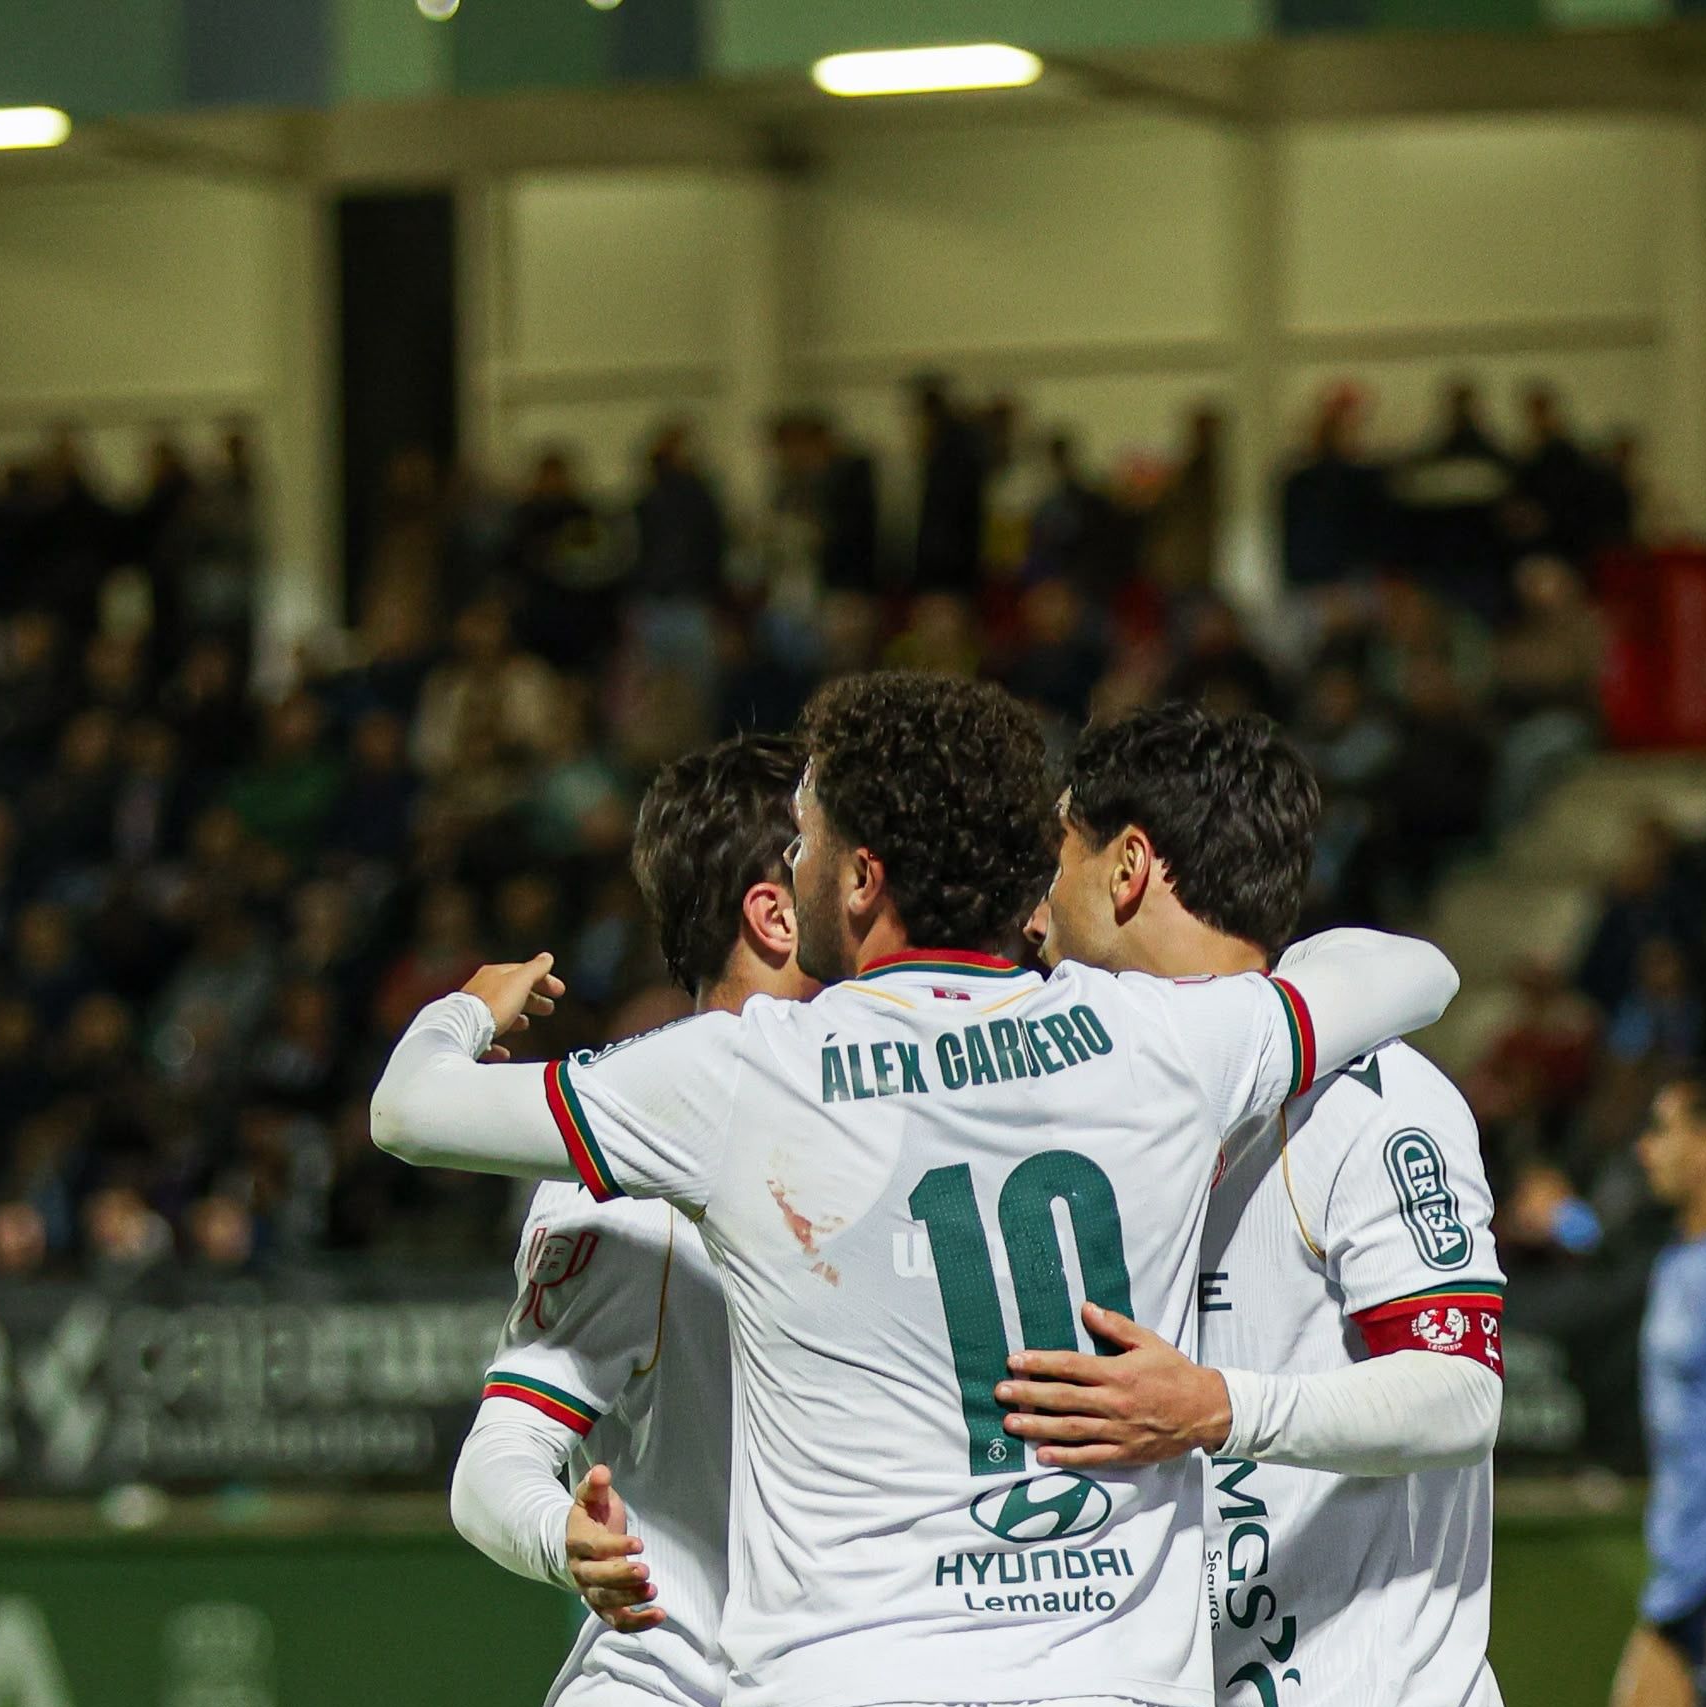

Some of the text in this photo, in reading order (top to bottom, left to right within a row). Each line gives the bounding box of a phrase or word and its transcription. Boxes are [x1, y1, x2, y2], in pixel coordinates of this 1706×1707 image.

[822, 1032, 930, 1104] ÁLEX
[907, 1149, 1138, 1477] 10
[935, 1547, 1135, 1587] HYUNDAI
[1211, 1455, 1277, 1630] MGS
[964, 1585, 1117, 1613] Lemauto
